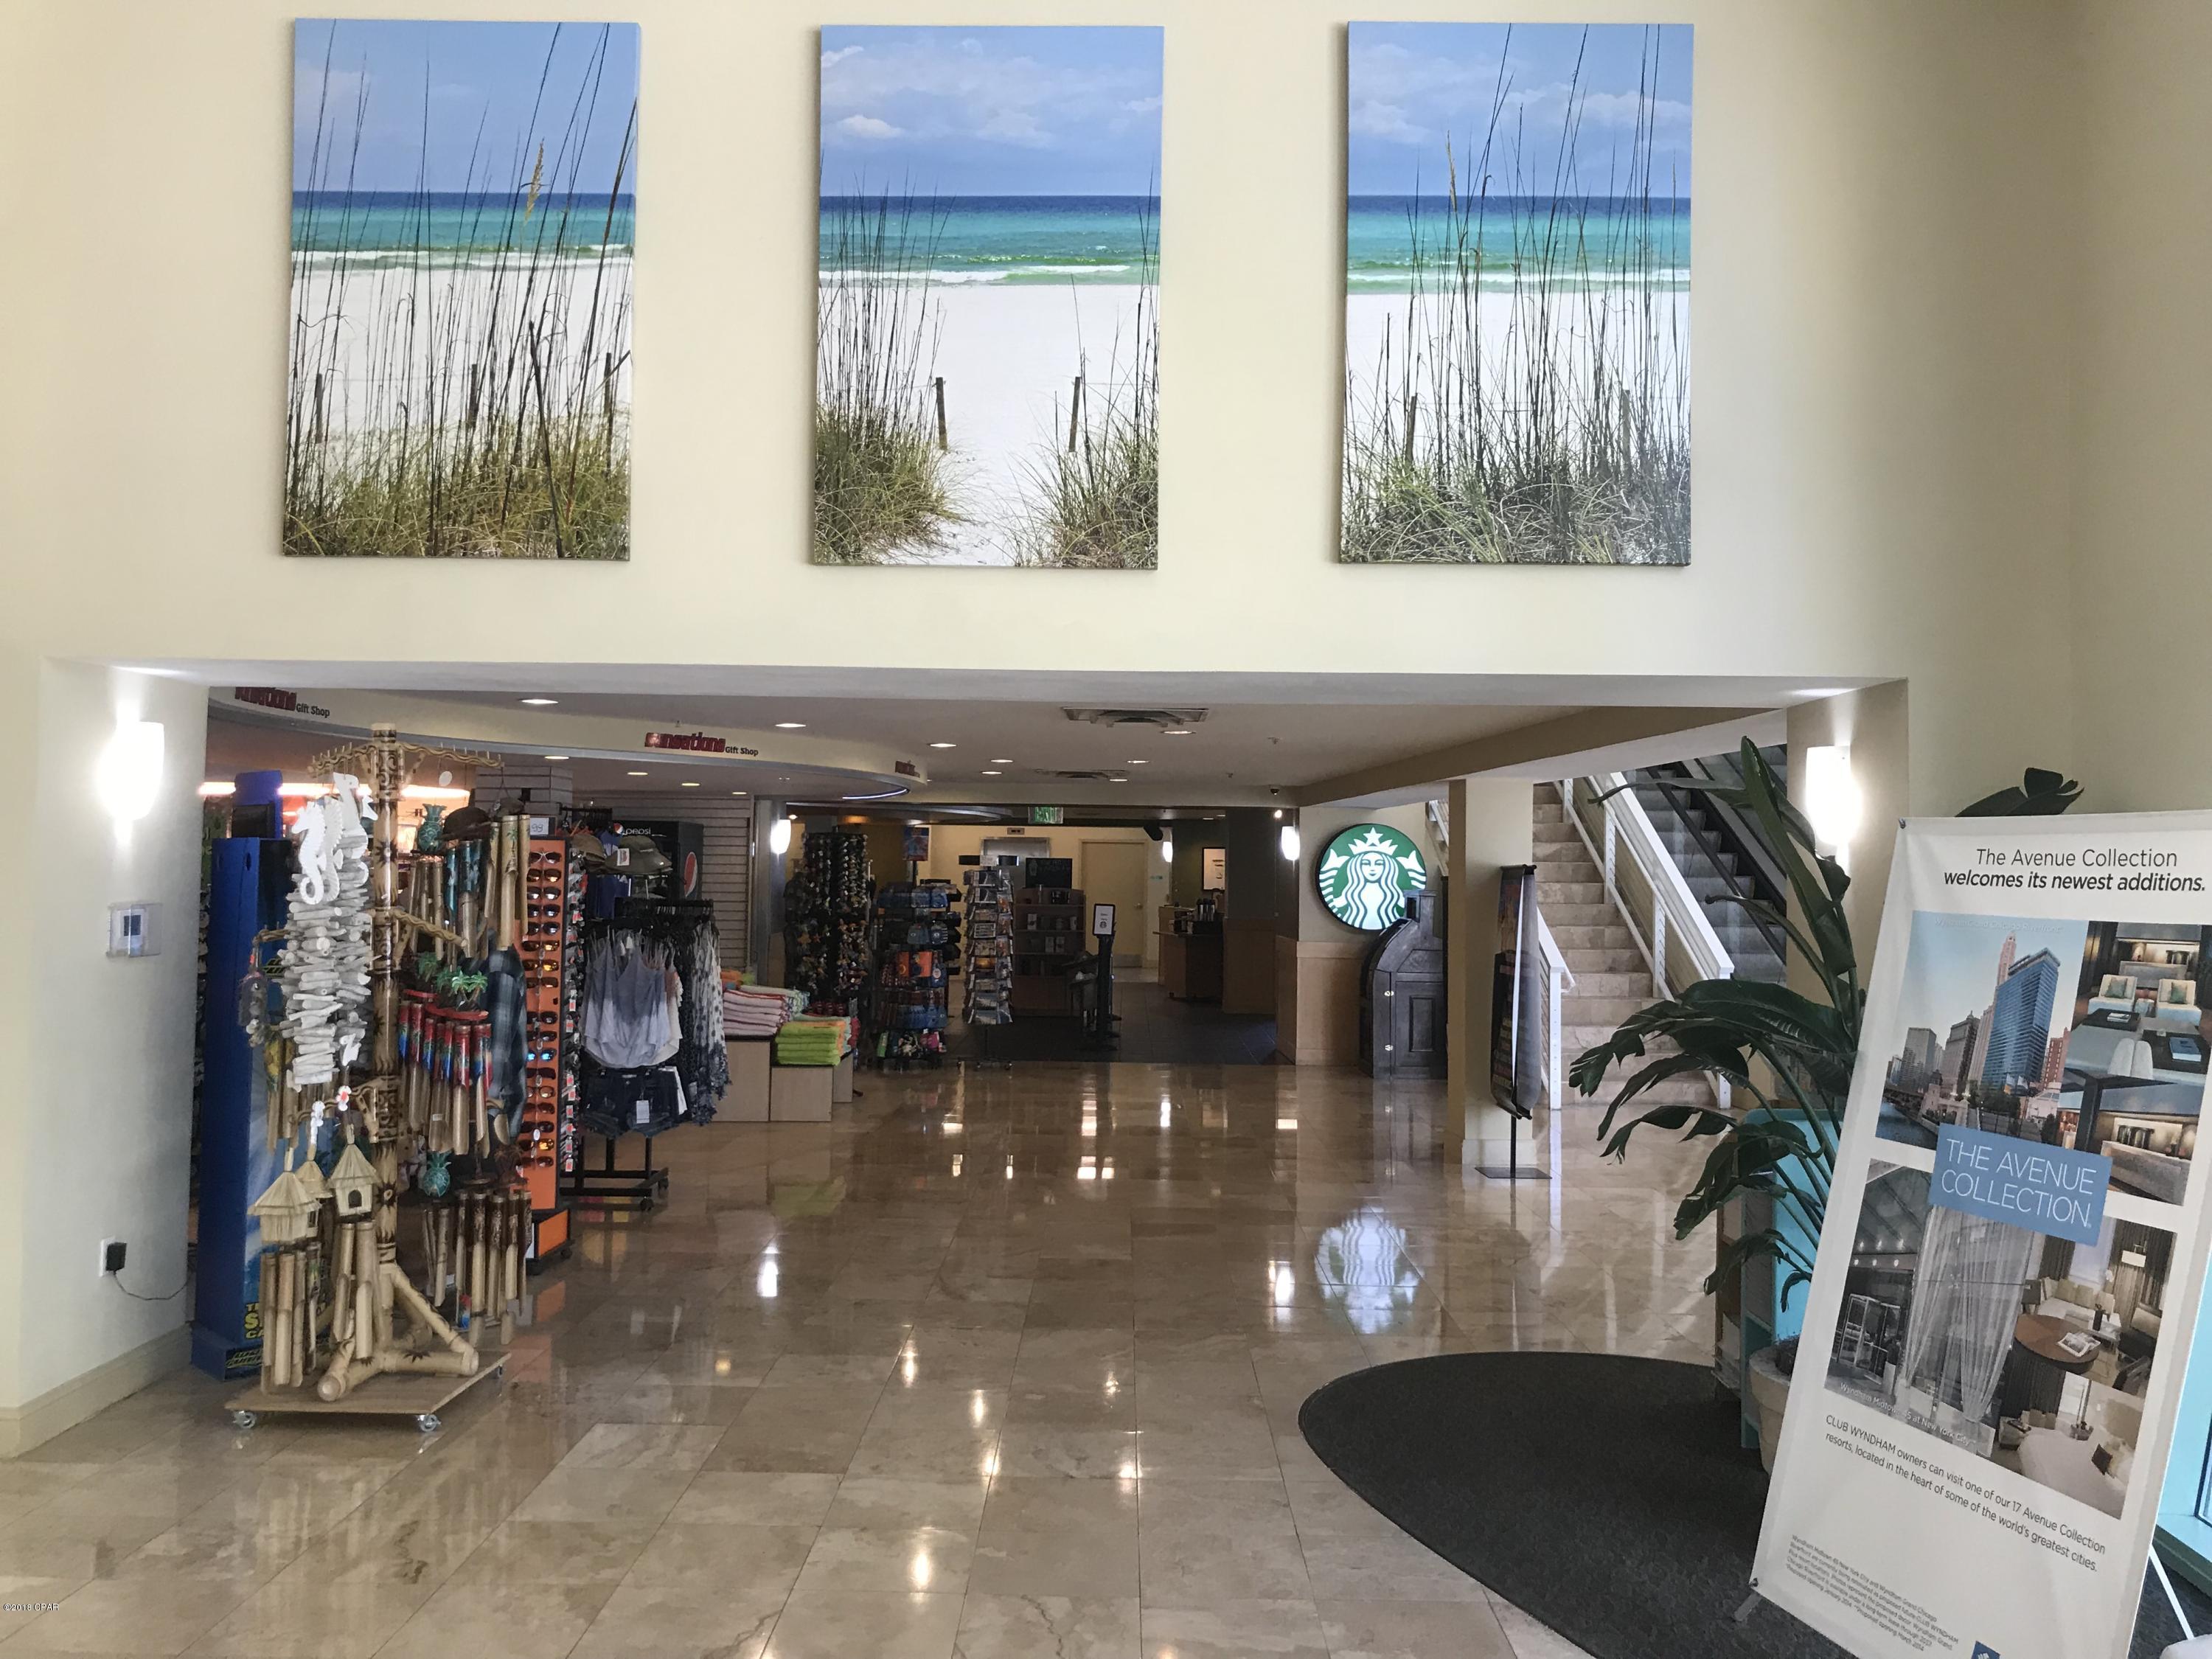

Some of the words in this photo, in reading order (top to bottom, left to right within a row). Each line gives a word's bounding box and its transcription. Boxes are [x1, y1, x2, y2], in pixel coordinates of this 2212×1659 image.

[310, 705, 330, 718] Shop
[725, 746, 739, 754] Gift
[740, 748, 759, 757] Shop
[625, 827, 651, 835] pepsi
[1976, 848, 2006, 866] The
[2011, 849, 2076, 867] Avenue
[2081, 849, 2178, 867] Collection
[1944, 869, 2024, 888] welcomes
[2027, 871, 2048, 889] its
[2051, 873, 2115, 891] newest
[2117, 872, 2206, 891] additions.
[1946, 1138, 1993, 1171] THE
[1996, 1151, 2097, 1194] AVENUE
[1826, 1415, 1848, 1432] CLUB
[1851, 1425, 1896, 1454] WYNDHAM
[1897, 1450, 1927, 1469] owners
[1929, 1464, 1944, 1477] can
[1947, 1472, 1964, 1486] visit
[1965, 1481, 1982, 1495] one
[1984, 1490, 1994, 1500] of
[1995, 1495, 2011, 1508] our
[2013, 1501, 2022, 1512] 17
[2023, 1507, 2057, 1531] Avenue
[2060, 1524, 2105, 1554] Collection
[1826, 1433, 1853, 1453] resorts,
[1855, 1444, 1885, 1467] located
[1886, 1462, 1893, 1471] in
[1896, 1464, 1909, 1479] the
[1910, 1471, 1933, 1490] heart
[1934, 1486, 1944, 1495] of
[1945, 1490, 1969, 1507] some
[1970, 1503, 1981, 1512] of
[1982, 1506, 1996, 1521] the
[1999, 1516, 2029, 1537] world's
[2031, 1533, 2070, 1557] greatest
[2071, 1552, 2097, 1572] cities.
